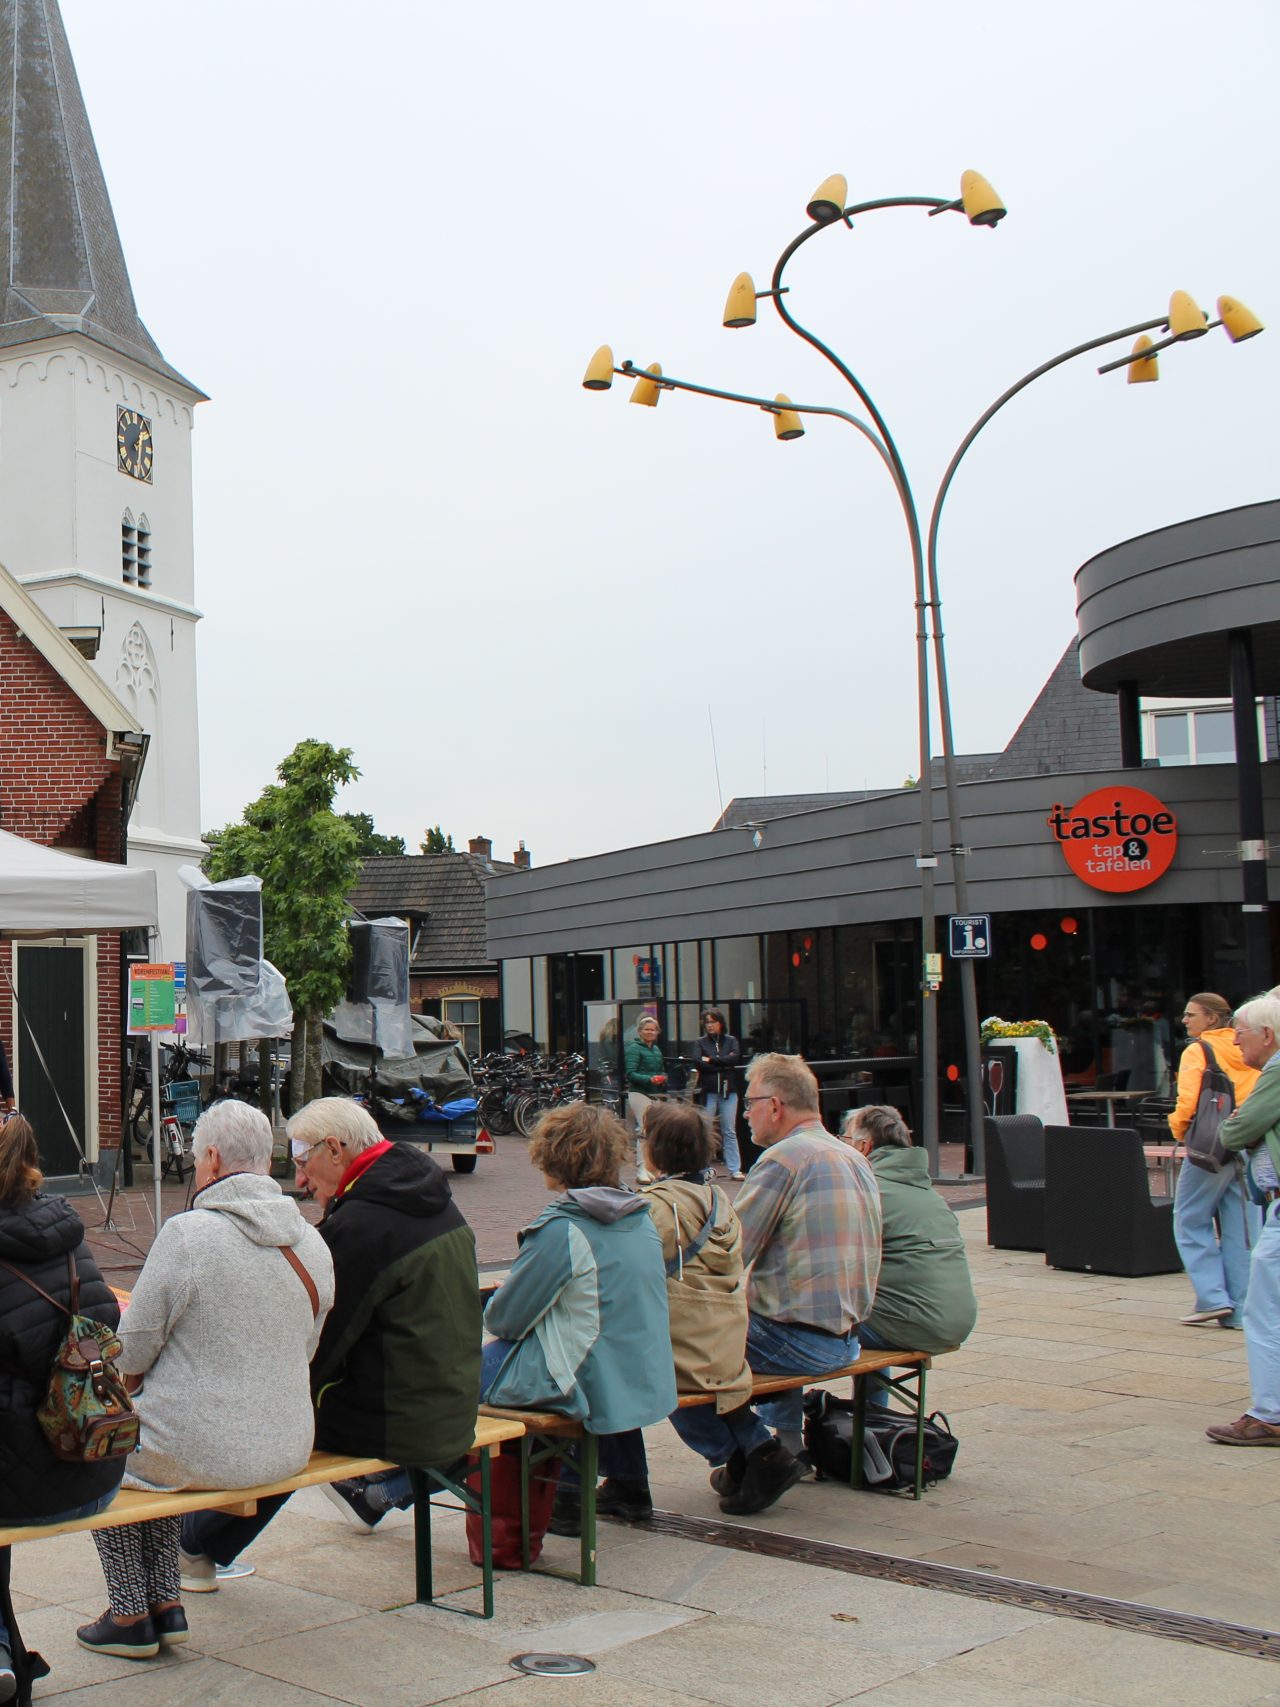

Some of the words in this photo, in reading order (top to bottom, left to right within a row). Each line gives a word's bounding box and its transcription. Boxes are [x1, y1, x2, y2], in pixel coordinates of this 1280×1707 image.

[1049, 801, 1174, 840] tastoe
[1092, 843, 1124, 860] tap
[1128, 841, 1141, 856] &
[1085, 857, 1151, 873] tafelen
